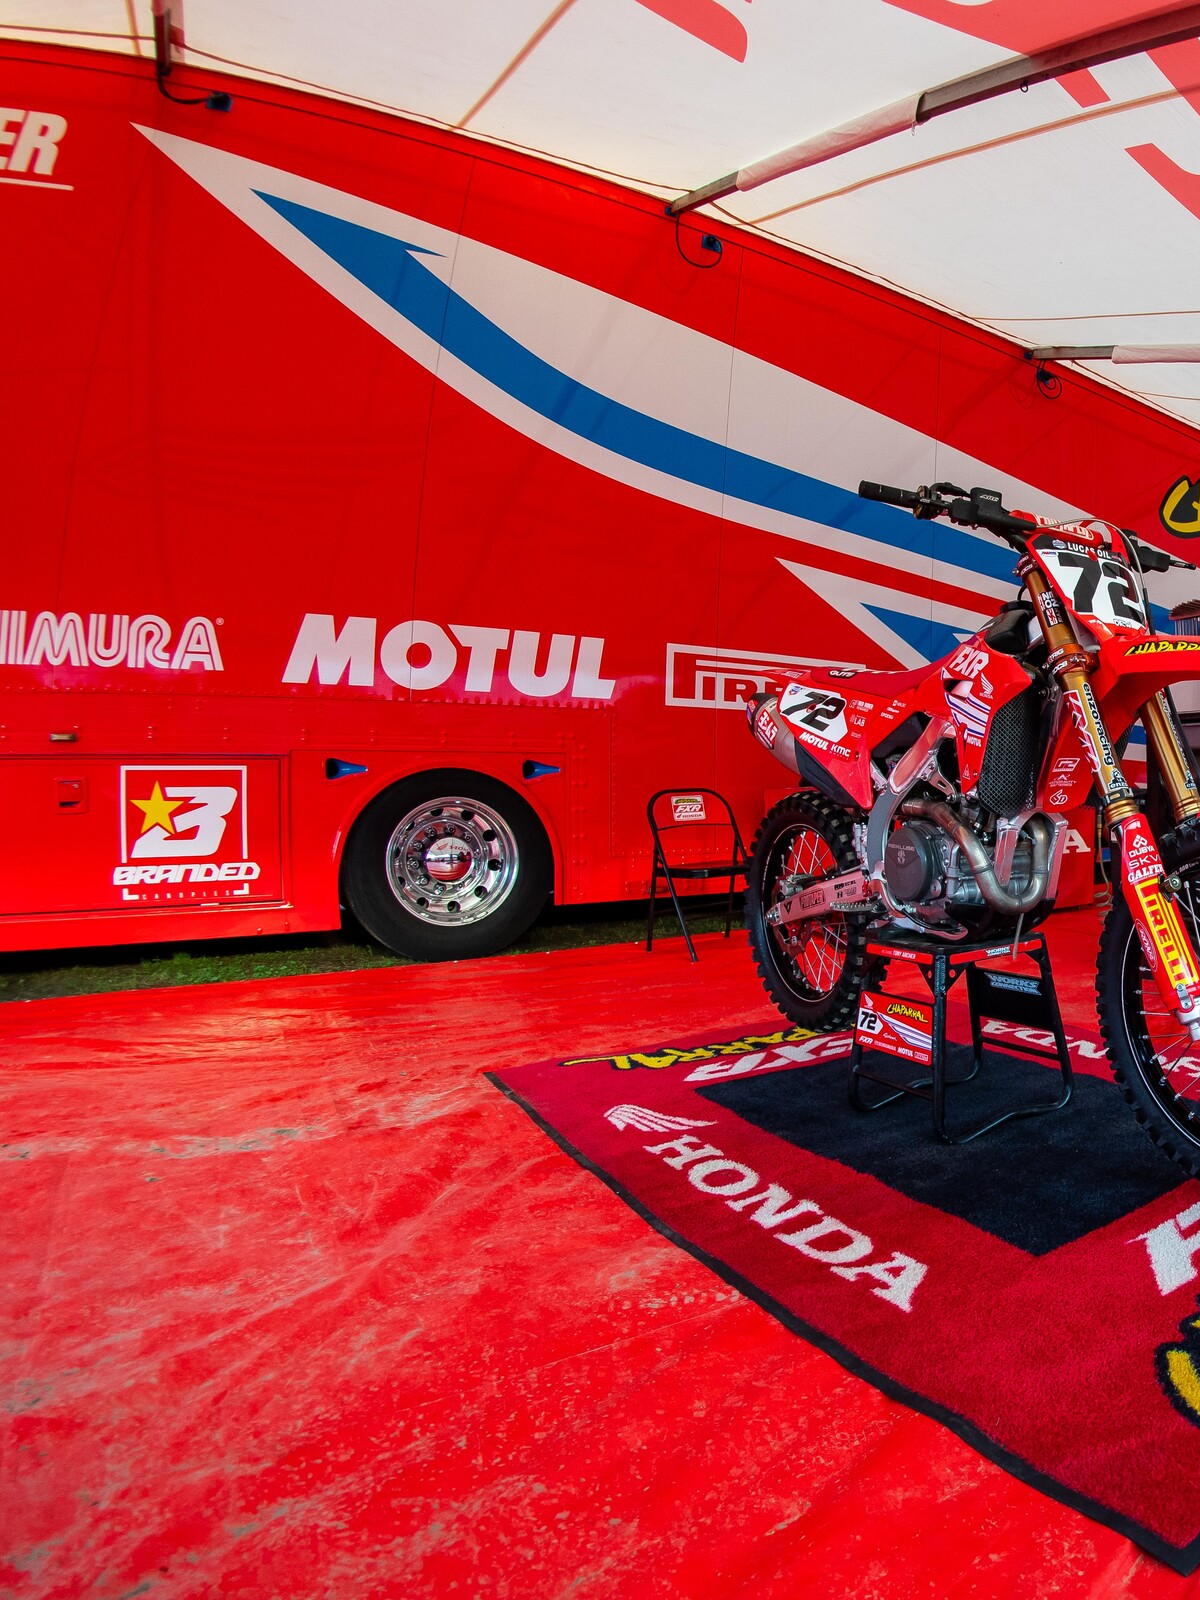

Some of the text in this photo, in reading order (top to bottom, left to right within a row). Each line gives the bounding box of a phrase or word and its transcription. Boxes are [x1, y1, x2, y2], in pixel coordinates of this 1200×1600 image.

[1097, 549, 1111, 560] OIL
[1057, 552, 1146, 625] 72
[282, 613, 616, 699] MOTUL
[949, 647, 990, 678] FXR
[782, 691, 846, 732] 72
[800, 731, 828, 751] MOTUL
[1128, 845, 1155, 858] DUBYA
[113, 862, 260, 885] BRANDED
[984, 972, 1041, 988] WORKS
[859, 1010, 878, 1032] 72
[886, 1003, 929, 1023] CHAPARRAL
[897, 1046, 914, 1058] MOTUL
[642, 1133, 928, 1314] HONDA
